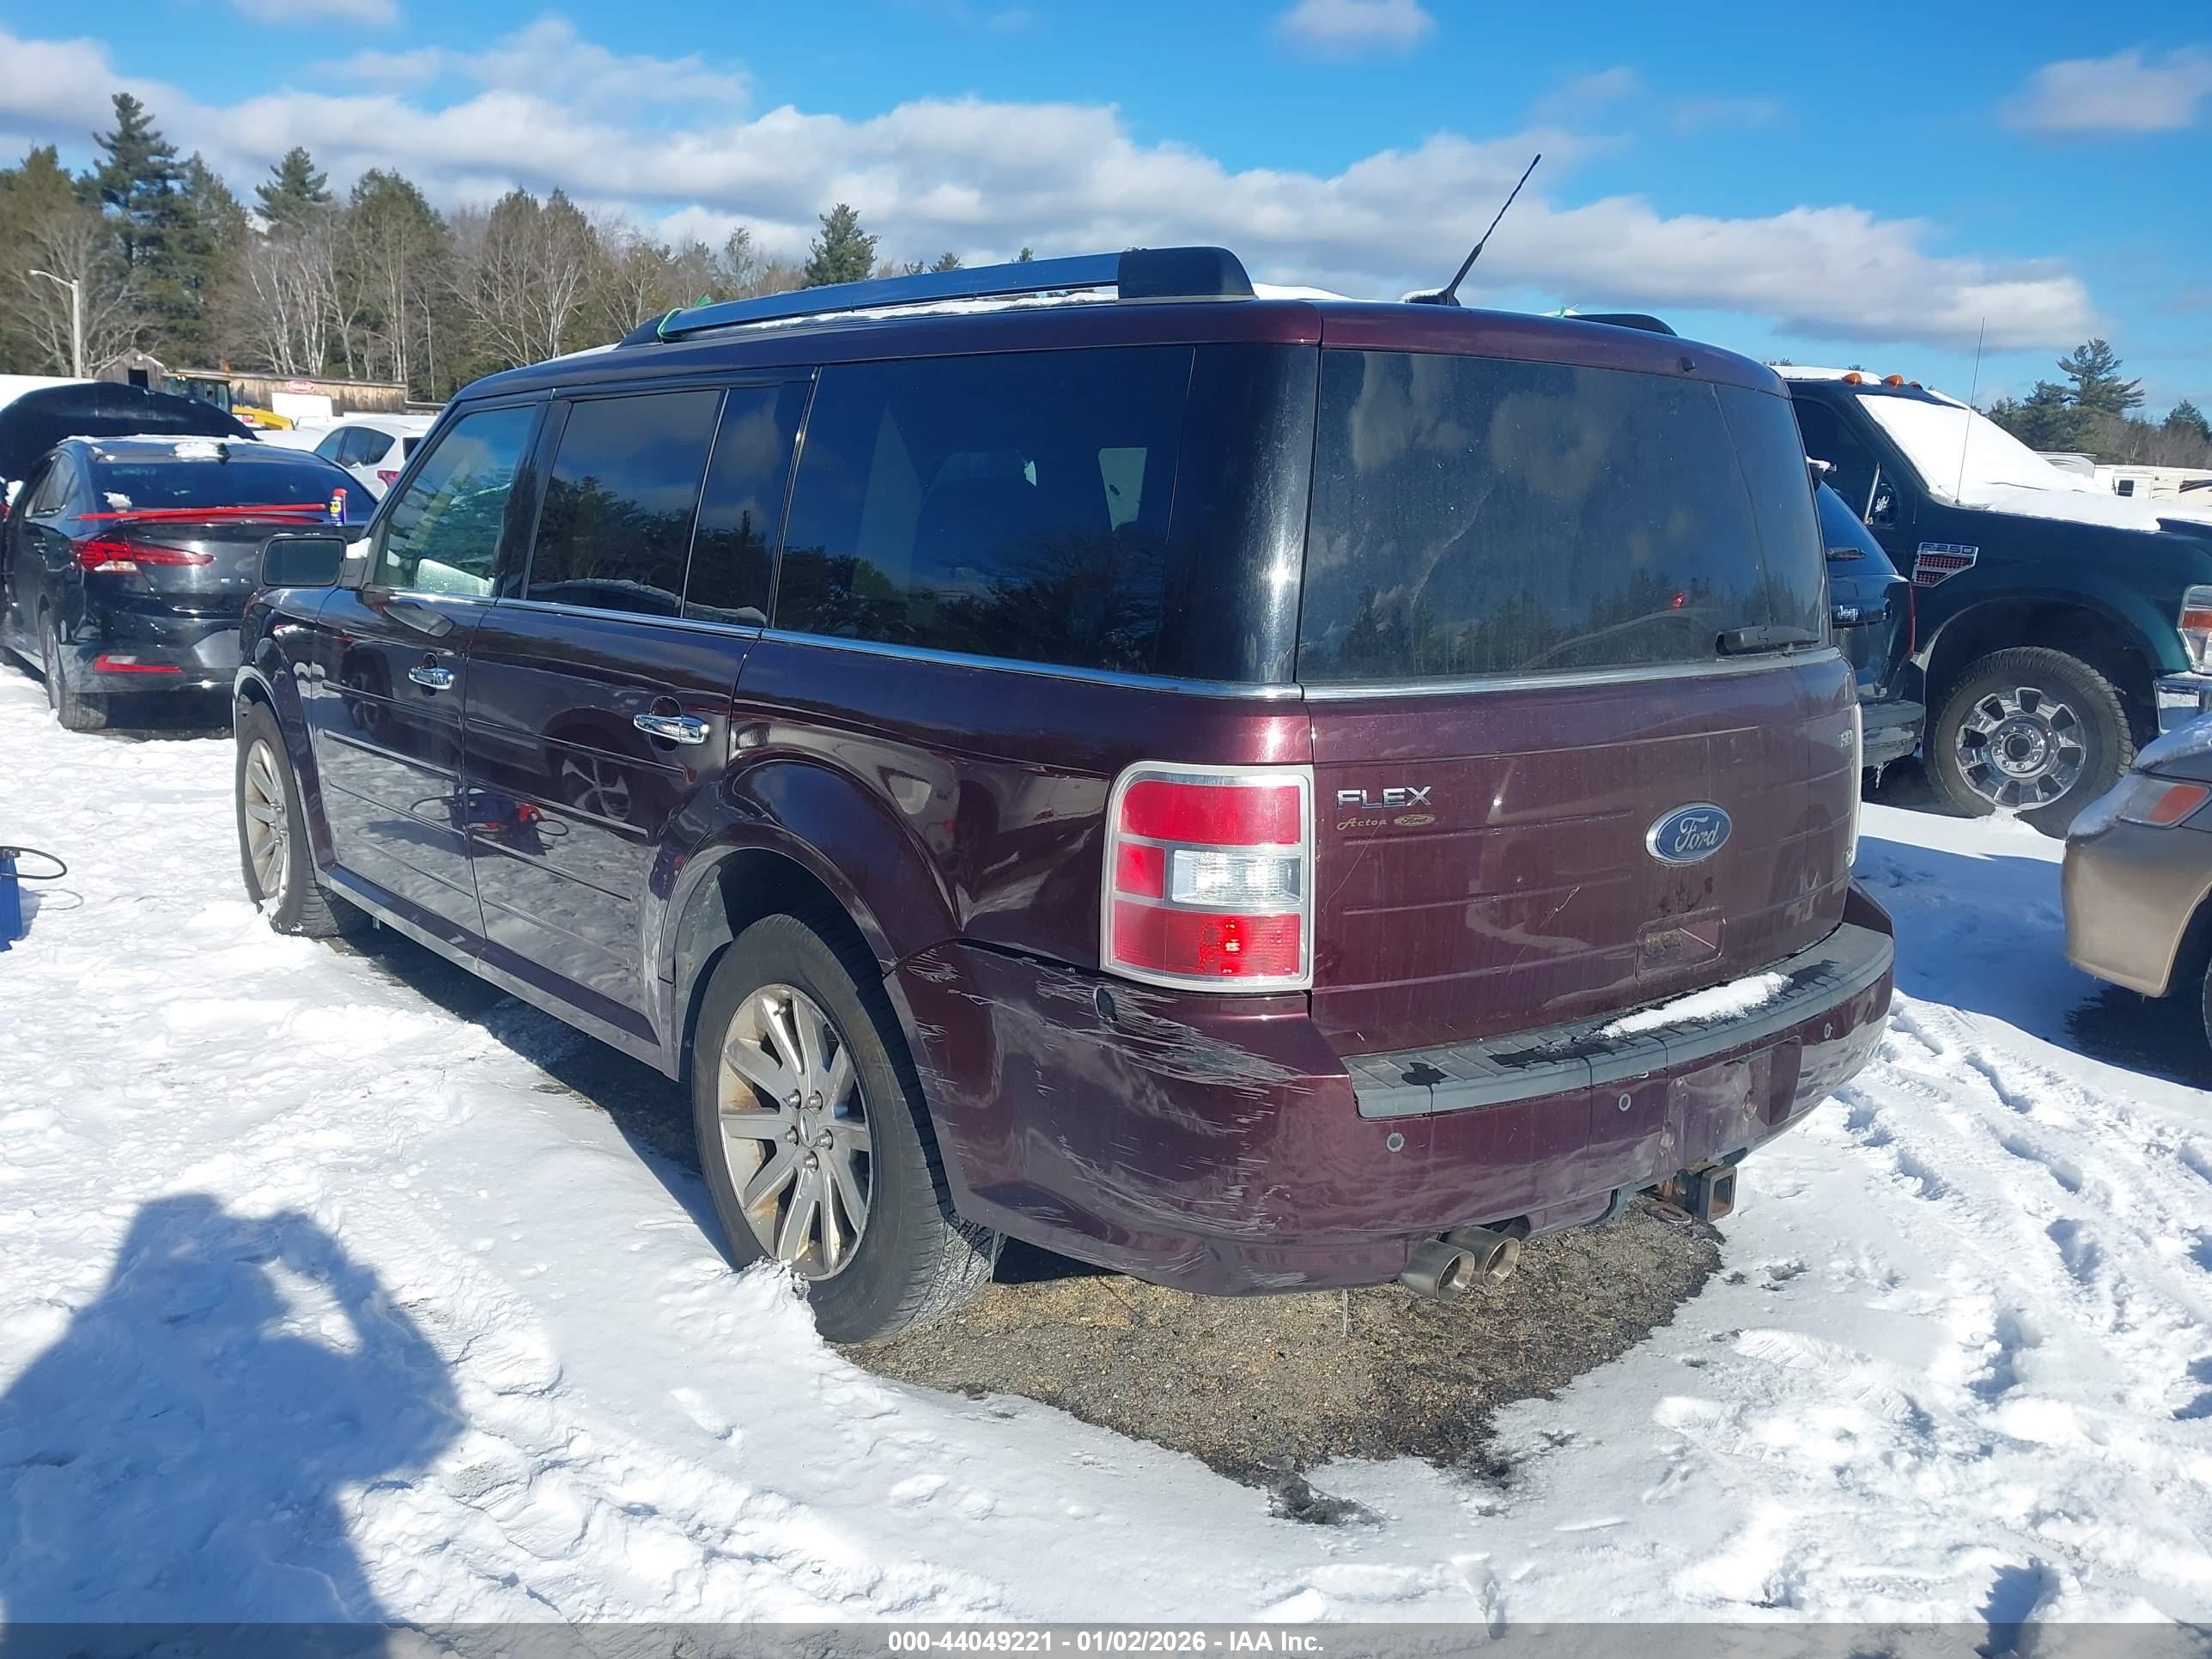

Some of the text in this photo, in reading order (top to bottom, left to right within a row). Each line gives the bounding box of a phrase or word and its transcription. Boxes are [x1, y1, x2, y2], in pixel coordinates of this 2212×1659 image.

[1837, 604, 1859, 622] Jeep
[1336, 786, 1432, 811] FLEX
[1674, 815, 1719, 853] Ford
